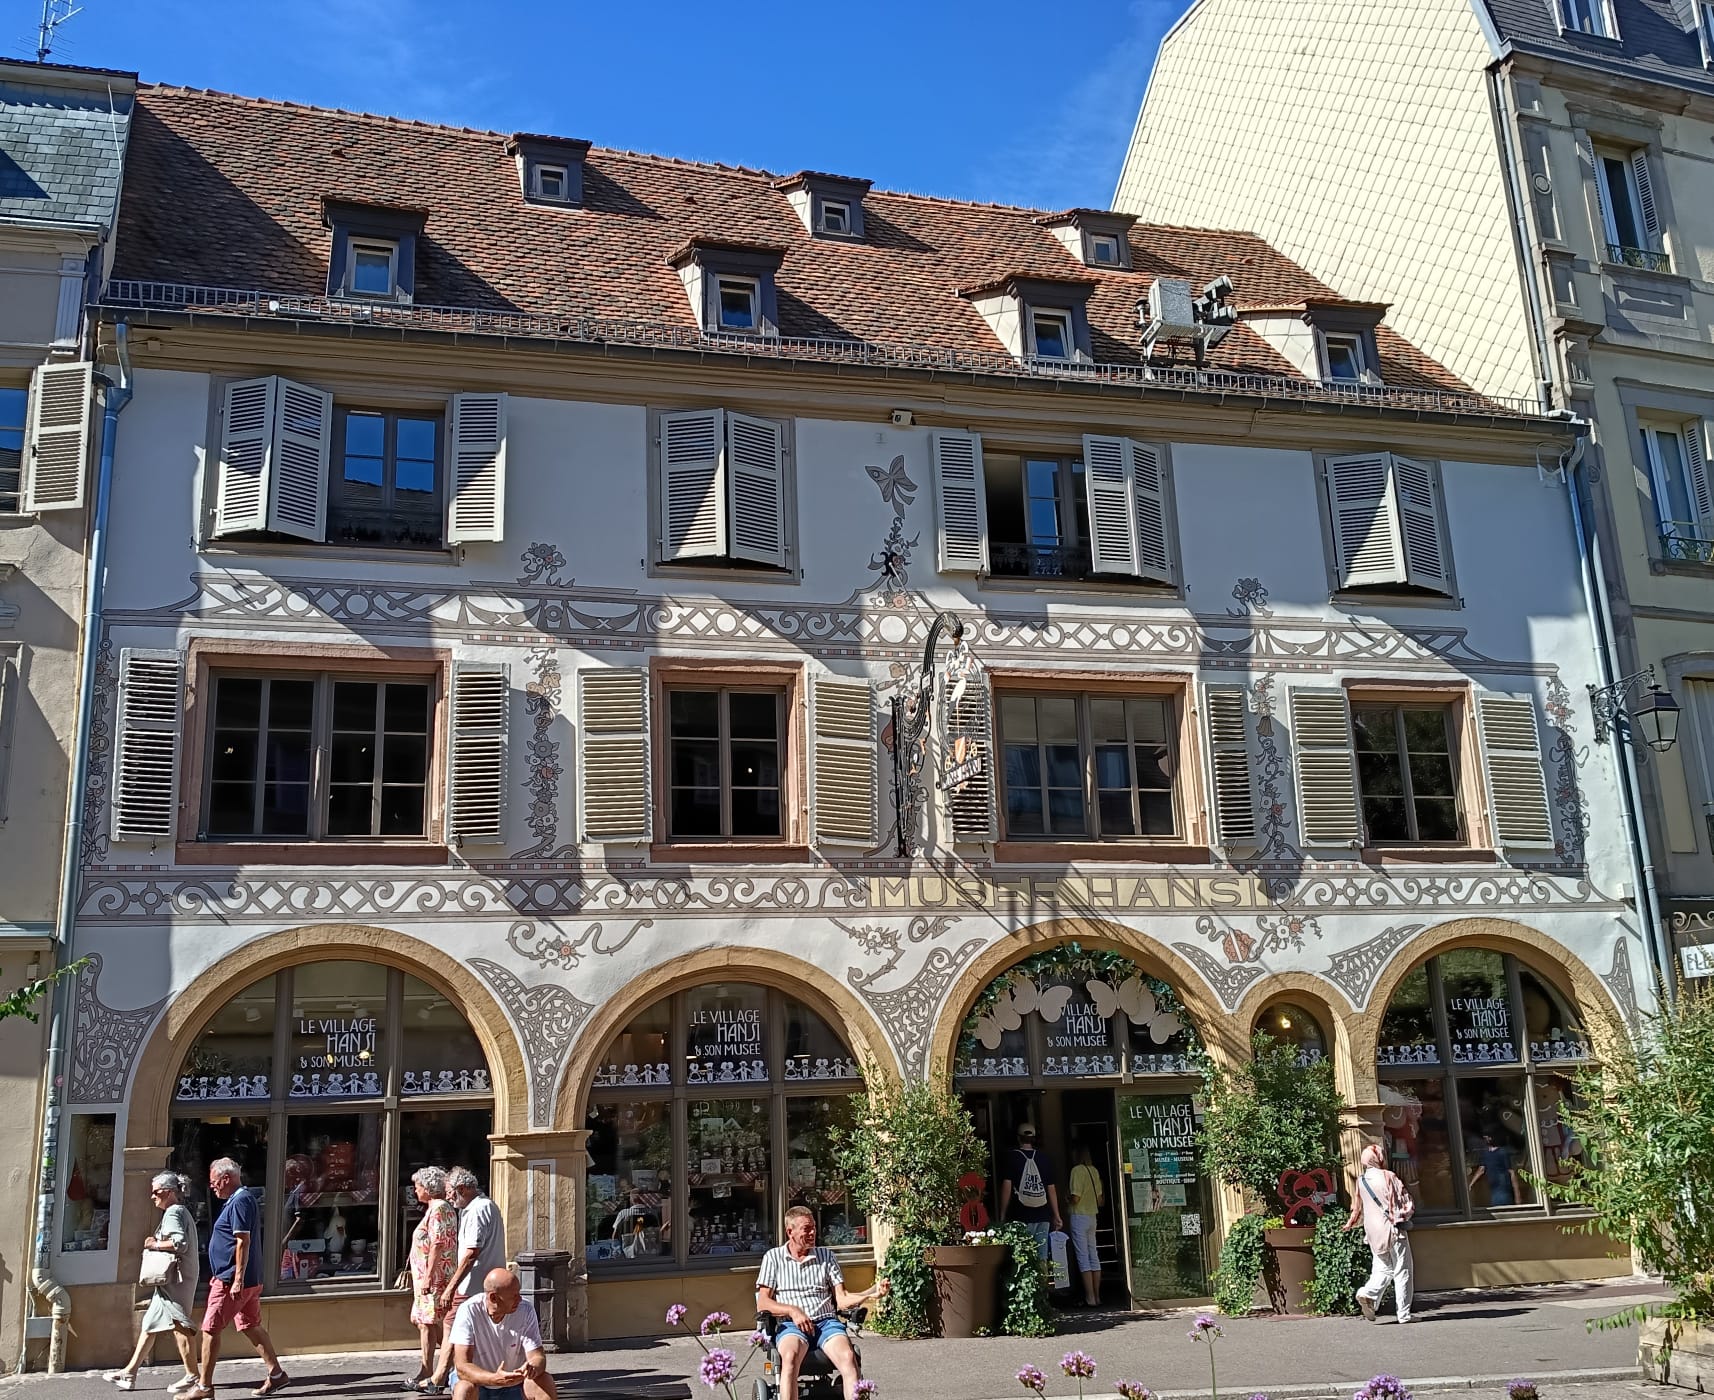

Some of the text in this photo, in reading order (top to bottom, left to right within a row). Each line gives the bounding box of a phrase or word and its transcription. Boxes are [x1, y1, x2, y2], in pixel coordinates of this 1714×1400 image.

[1086, 877, 1256, 909] HANSI
[1451, 998, 1505, 1011] LE VILLAGE
[693, 1009, 761, 1024] LE VILLAGE
[1472, 1009, 1508, 1028] HANSI
[300, 1018, 377, 1034] LE VILLAGE
[1066, 1015, 1107, 1034] HANSI
[717, 1023, 760, 1043] HANSI
[1455, 1028, 1463, 1040] &
[1463, 1028, 1479, 1039] SON
[326, 1032, 376, 1053] HANSI
[1046, 1036, 1054, 1048] &
[1055, 1036, 1072, 1048] SON
[694, 1044, 702, 1057] &
[704, 1044, 721, 1056] SON
[300, 1056, 308, 1069] &
[310, 1056, 330, 1068] SON
[1129, 1104, 1192, 1119] LE VILLAGE
[1152, 1117, 1194, 1137] HANSI
[1133, 1138, 1141, 1150] &
[1142, 1137, 1158, 1149] SON
